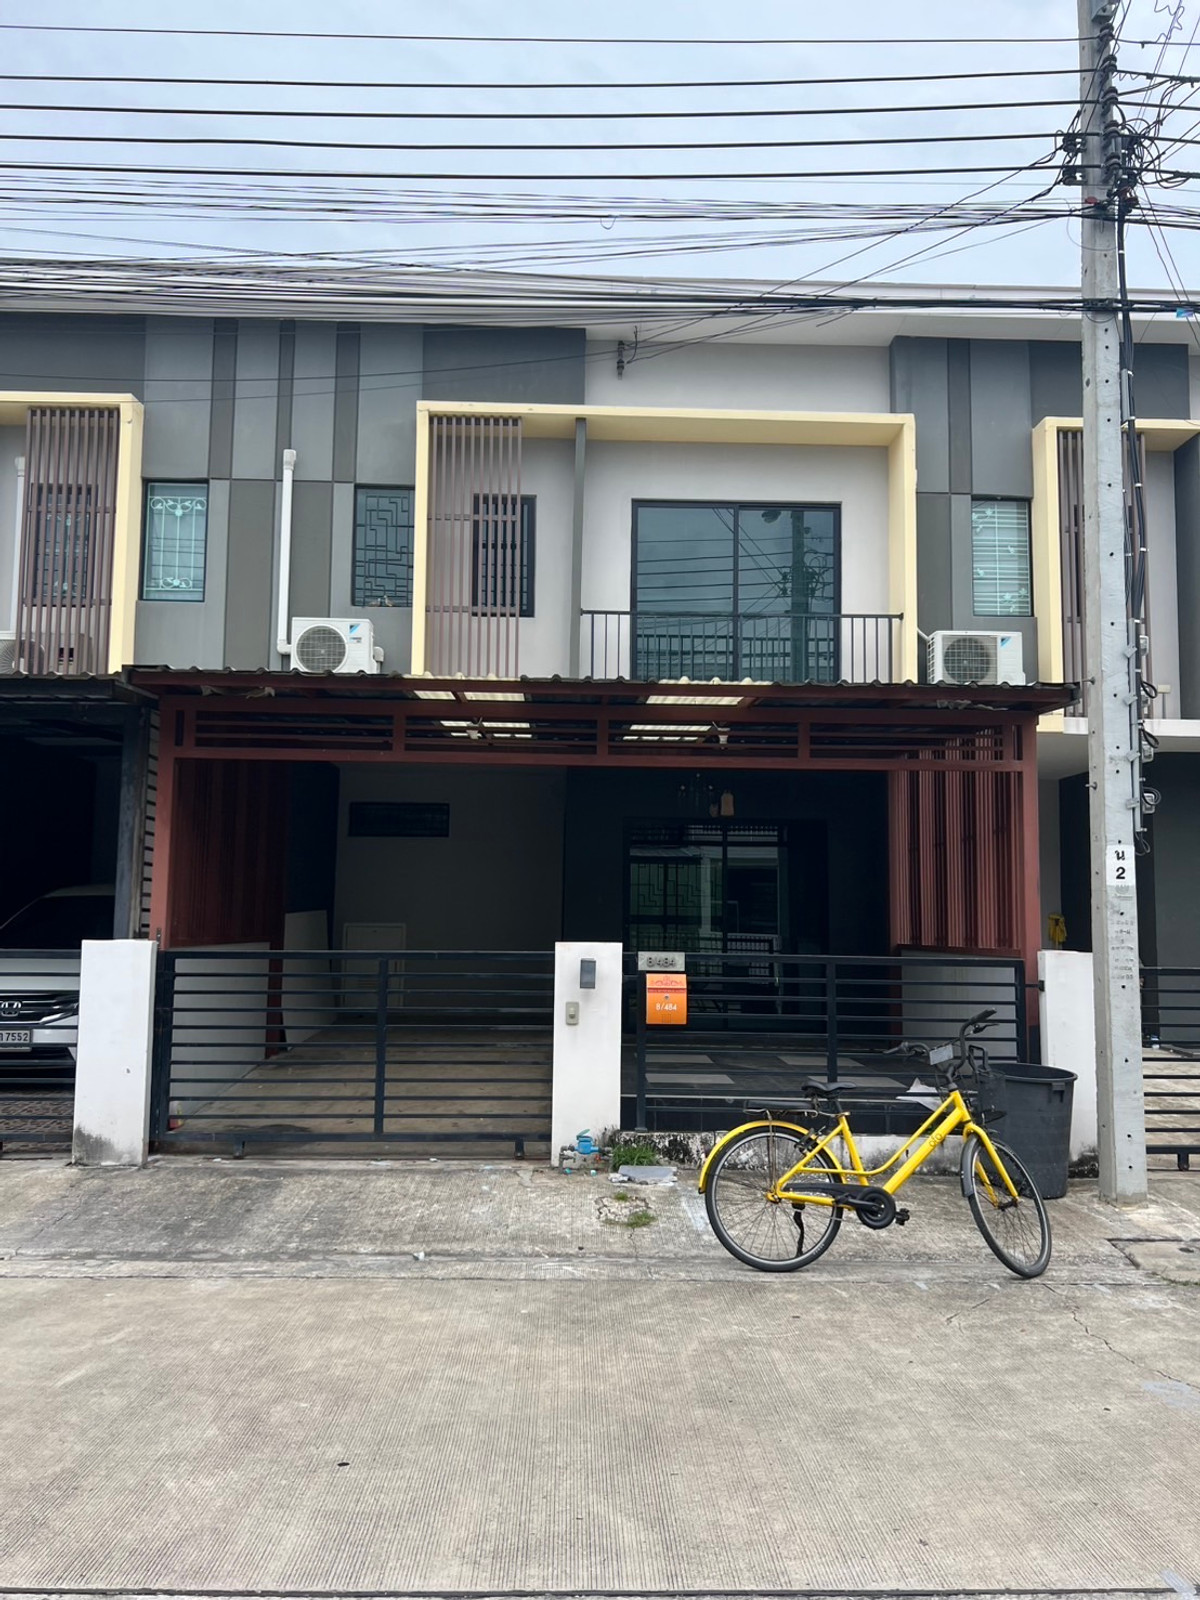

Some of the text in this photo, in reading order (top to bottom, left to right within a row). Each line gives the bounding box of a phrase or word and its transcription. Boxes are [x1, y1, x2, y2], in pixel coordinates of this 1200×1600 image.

[1114, 849, 1126, 861] น
[1115, 866, 1126, 880] 2
[646, 956, 677, 968] 8/484
[655, 1003, 678, 1011] 8/484
[5, 1032, 29, 1042] 7552
